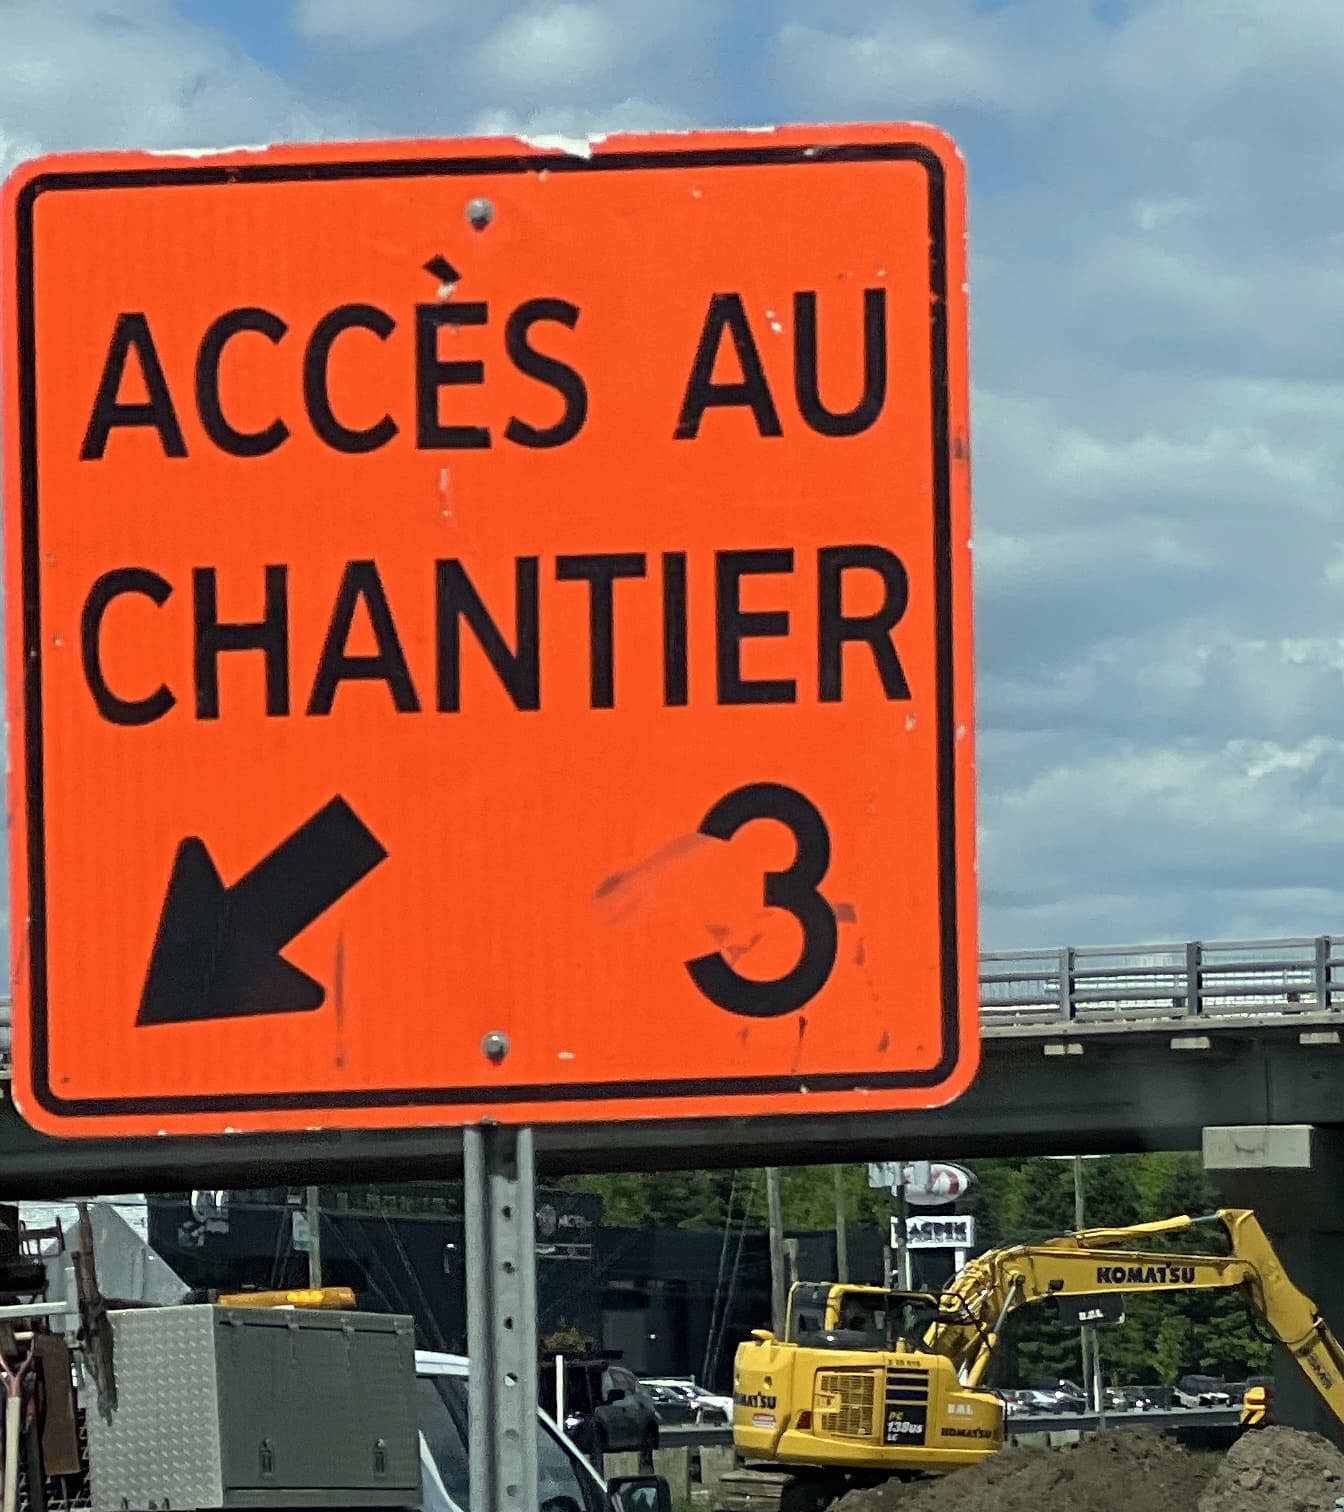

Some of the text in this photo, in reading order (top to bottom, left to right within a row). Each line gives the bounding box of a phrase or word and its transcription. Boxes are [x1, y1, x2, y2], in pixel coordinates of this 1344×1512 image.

[79, 255, 888, 461] ACCÈS AU
[80, 543, 912, 726] CHANTIER
[684, 782, 838, 1019] 3
[1097, 1263, 1195, 1284] KOMATSU
